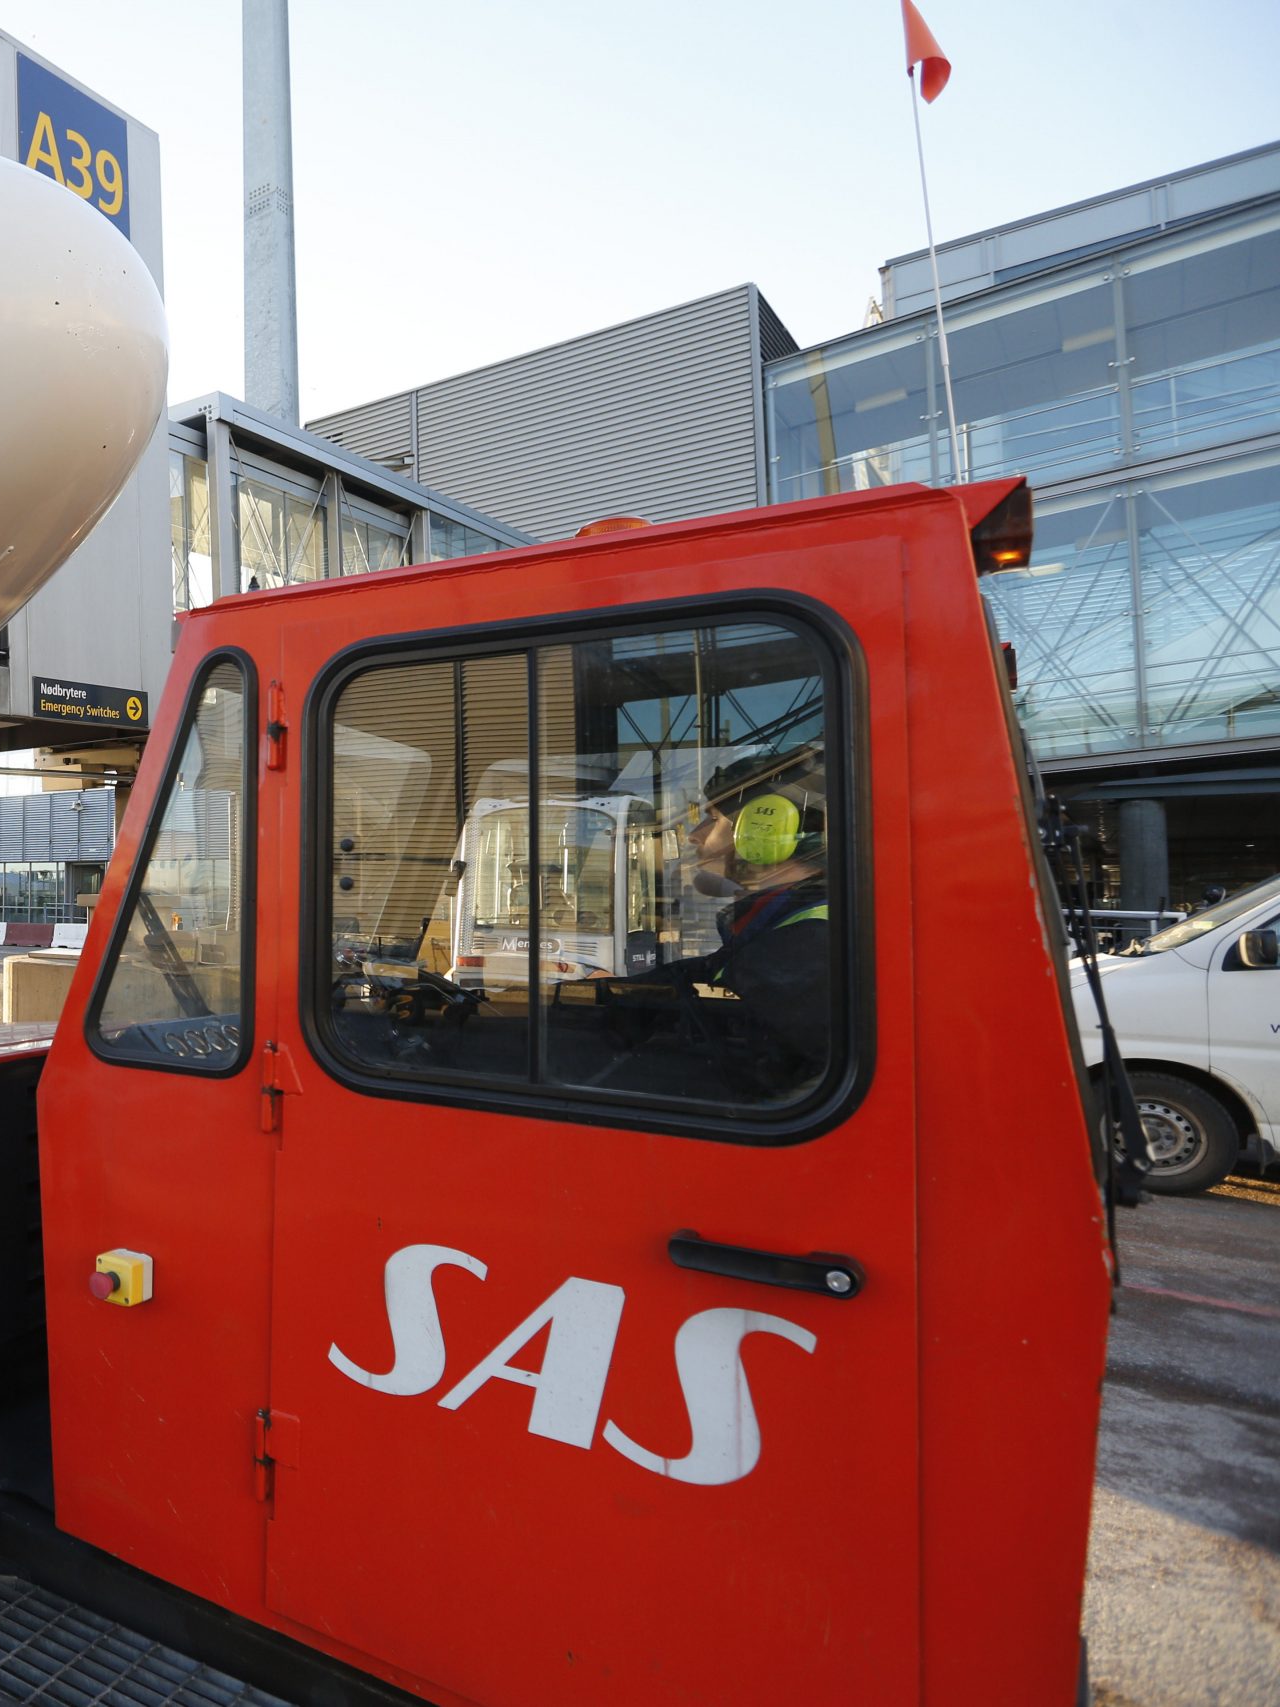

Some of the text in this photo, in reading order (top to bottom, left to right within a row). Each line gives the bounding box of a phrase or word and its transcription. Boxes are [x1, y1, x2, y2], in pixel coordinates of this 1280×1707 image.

[25, 111, 123, 216] A39
[40, 682, 87, 700] Nødbrytere
[40, 699, 120, 719] Emergency Switches
[753, 806, 776, 816] SAS
[328, 1244, 817, 1486] SAS
